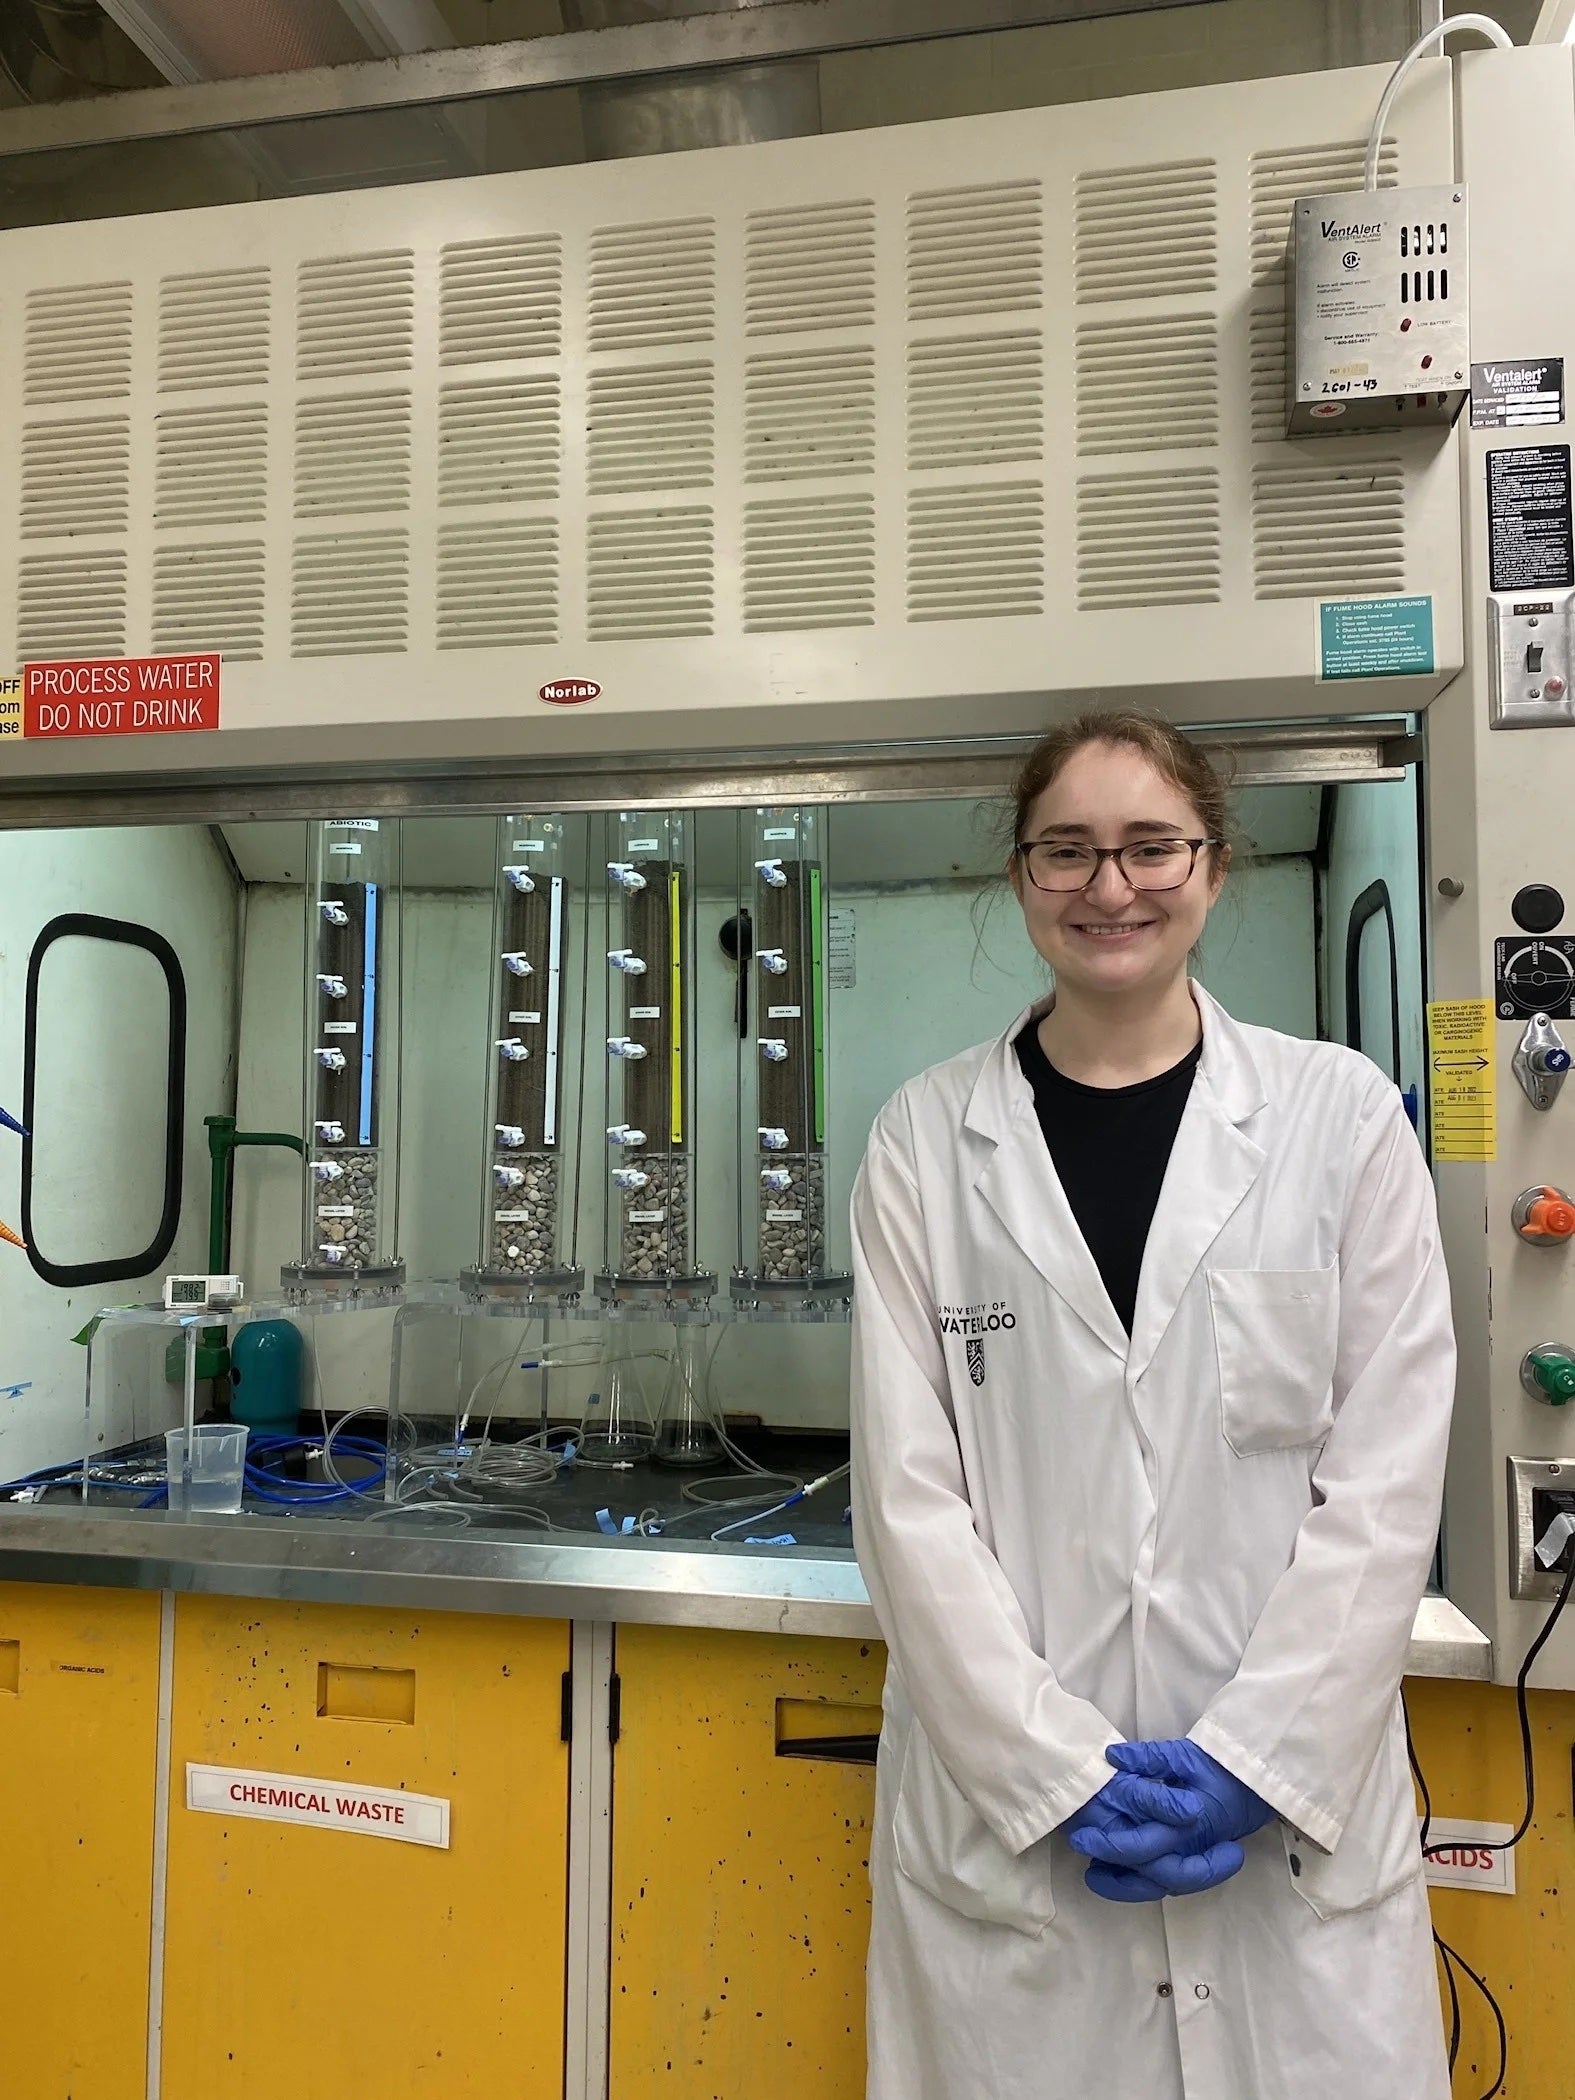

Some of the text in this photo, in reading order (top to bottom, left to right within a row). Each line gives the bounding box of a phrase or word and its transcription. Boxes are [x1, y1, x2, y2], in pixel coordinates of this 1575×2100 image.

[1321, 220, 1381, 238] VentAlert
[1483, 367, 1542, 383] Ventalert
[1493, 386, 1538, 394] VALIDATION
[31, 661, 213, 696] PROCESS WATER
[544, 684, 597, 699] Norlab
[40, 697, 203, 731] DO NOT DRINK
[992, 1301, 1006, 1311] OF
[230, 1784, 405, 1825] CHEMICAL WASTE
